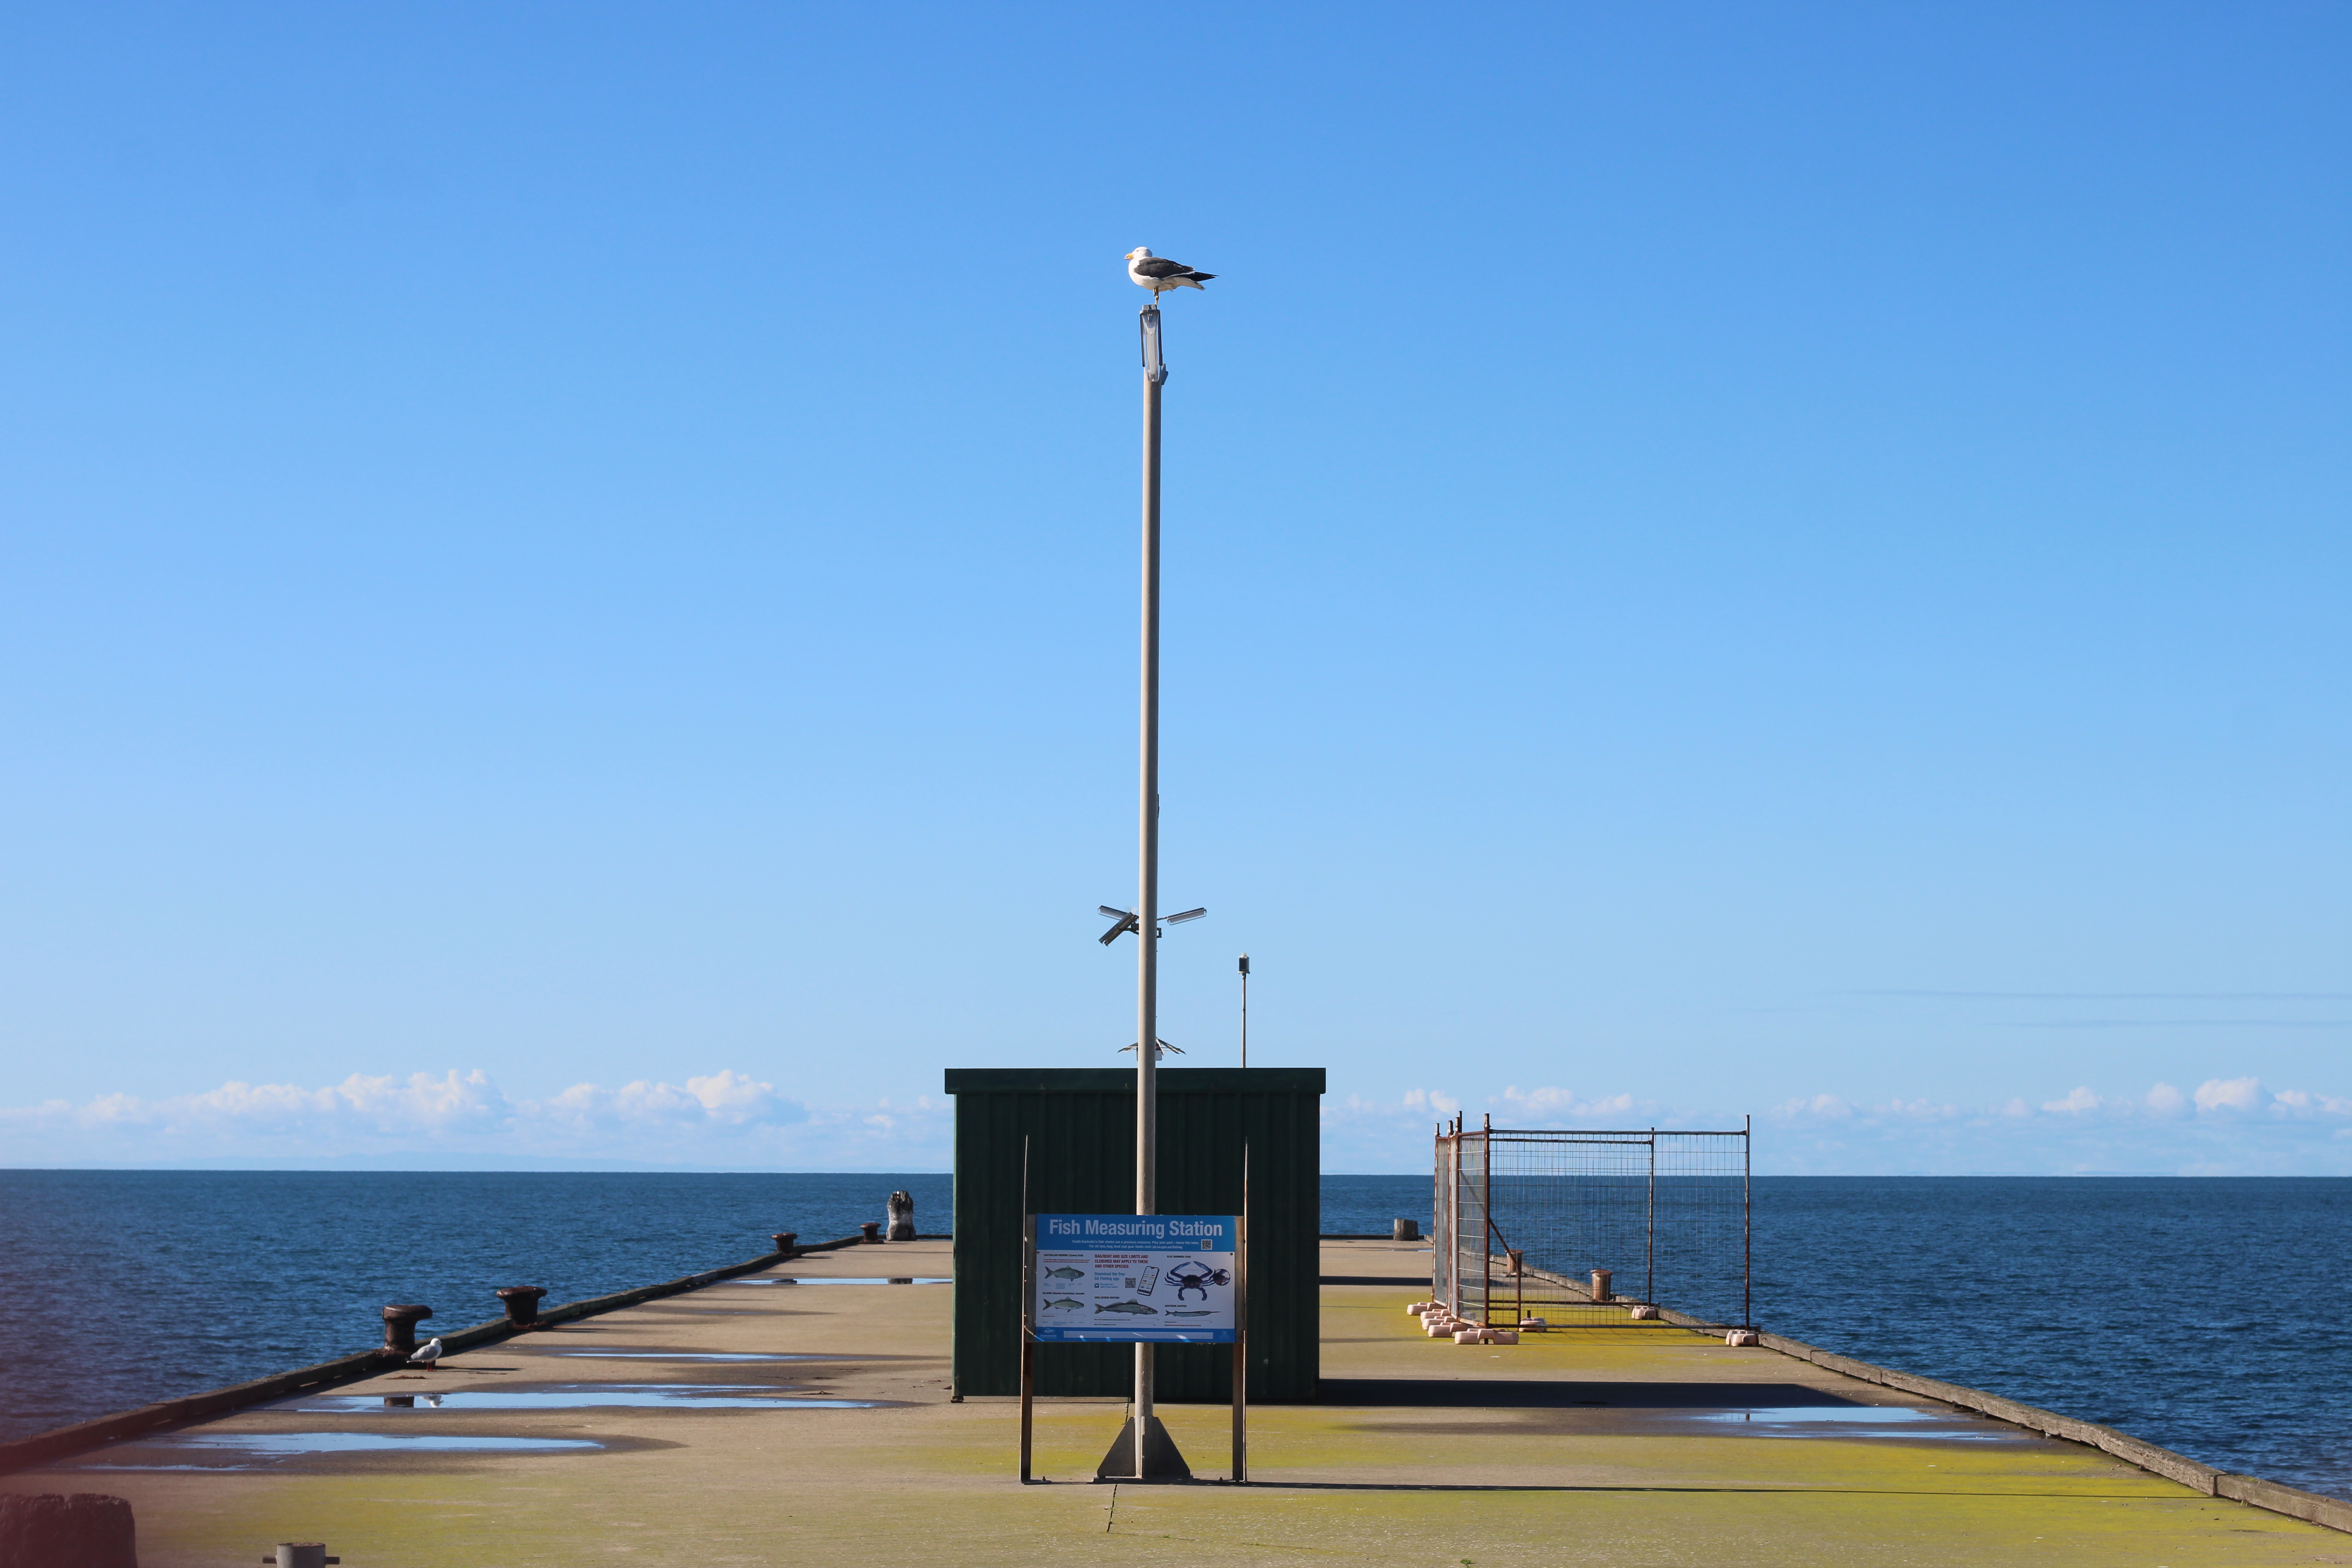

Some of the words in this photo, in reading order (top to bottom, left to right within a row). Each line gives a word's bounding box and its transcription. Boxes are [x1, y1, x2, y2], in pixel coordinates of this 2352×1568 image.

[1050, 1220, 1080, 1234] Fish
[1085, 1220, 1164, 1239] Measuring
[1169, 1220, 1222, 1236] Station
